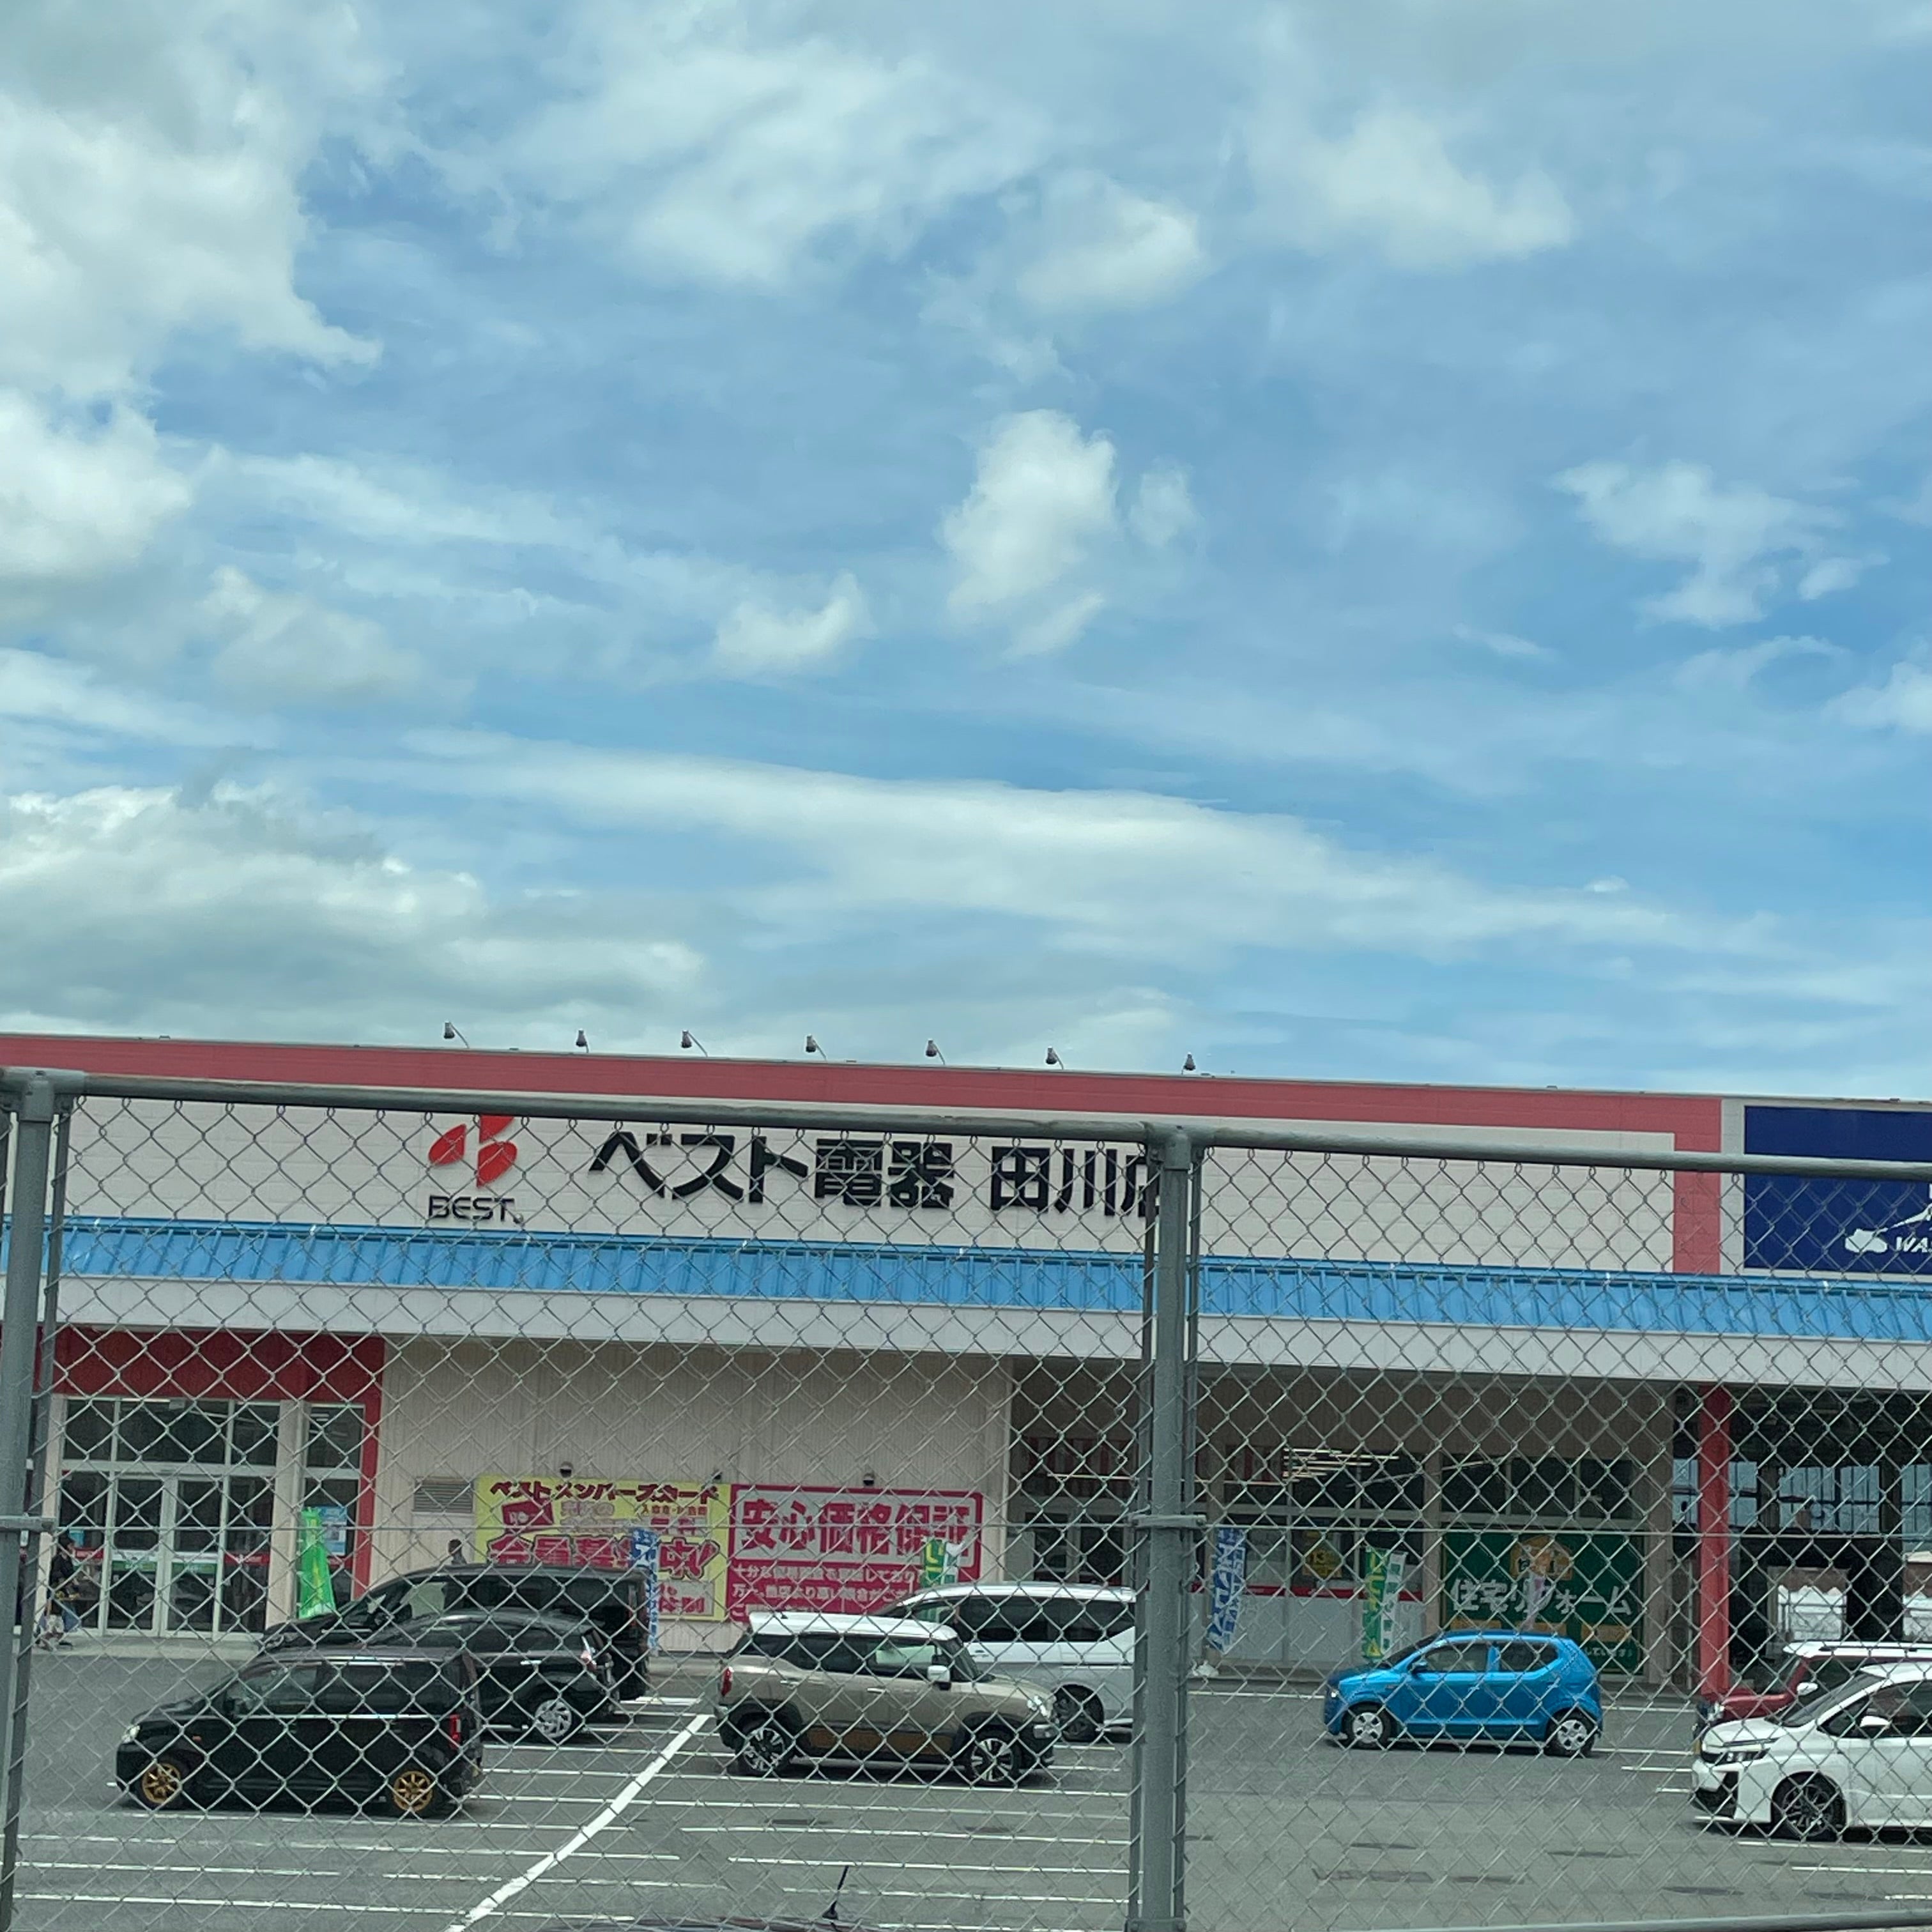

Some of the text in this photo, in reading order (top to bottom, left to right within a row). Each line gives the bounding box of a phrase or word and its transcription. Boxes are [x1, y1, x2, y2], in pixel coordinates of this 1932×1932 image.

[588, 1131, 954, 1208] ベスト電器
[429, 1195, 514, 1222] BEST
